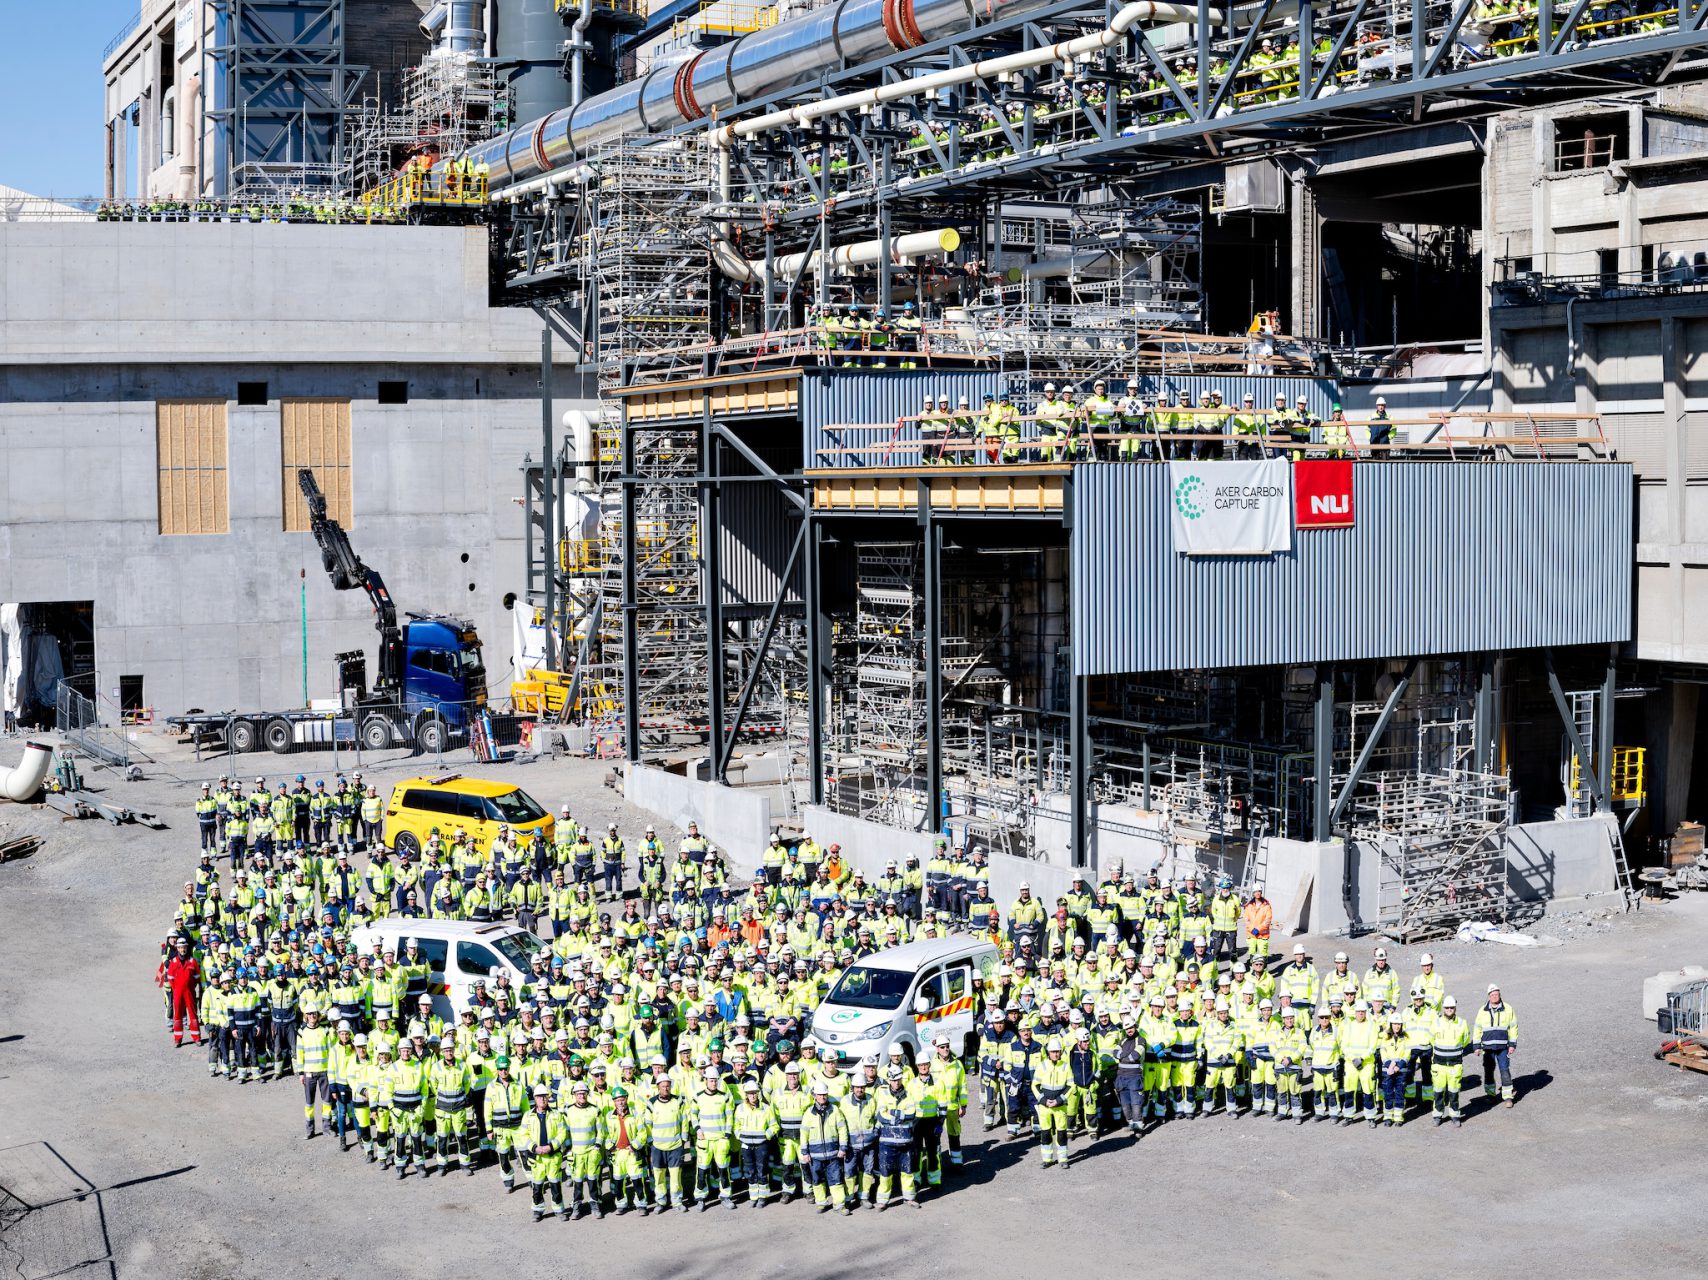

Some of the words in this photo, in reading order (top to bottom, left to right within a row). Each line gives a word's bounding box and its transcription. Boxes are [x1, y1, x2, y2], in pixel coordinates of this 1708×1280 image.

[1214, 486, 1240, 497] AKER
[1242, 486, 1284, 497] CARBON
[1214, 498, 1260, 510] CAPTURE
[1310, 494, 1349, 514] NLI
